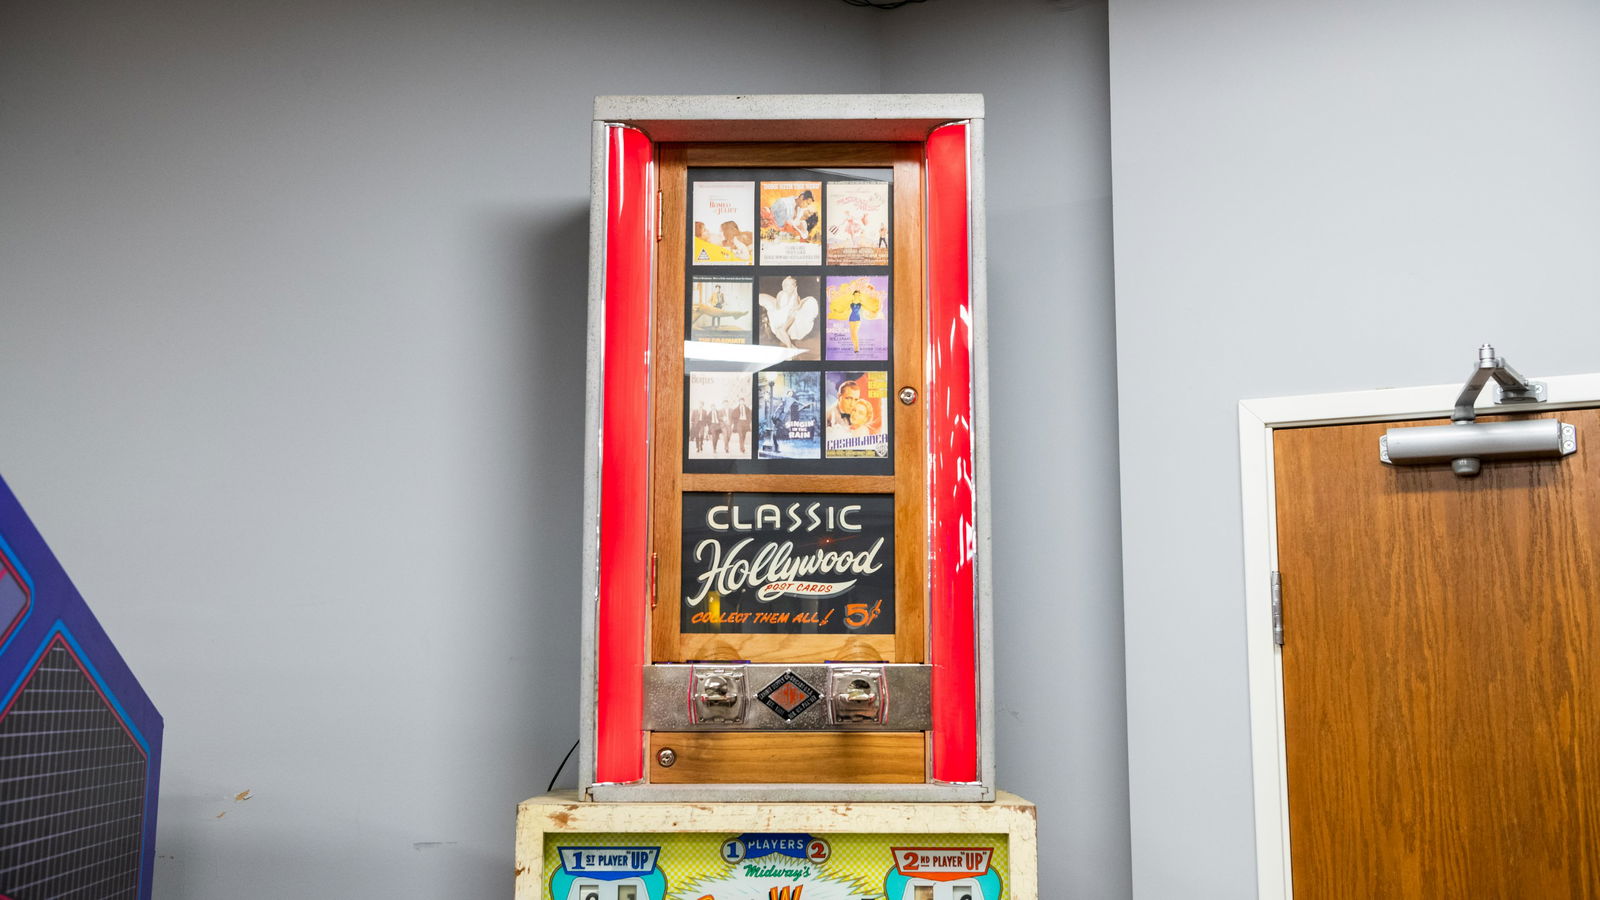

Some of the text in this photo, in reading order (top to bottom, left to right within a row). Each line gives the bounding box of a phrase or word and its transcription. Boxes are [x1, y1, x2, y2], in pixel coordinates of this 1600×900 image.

[788, 431, 811, 439] RAIN
[827, 433, 888, 451] CASABLANCA
[707, 502, 862, 532] CLASSIC
[686, 537, 885, 606] Hollywood
[764, 582, 833, 593] POST CARDS
[691, 612, 752, 624] COLLECT
[753, 612, 790, 624] THEM
[726, 839, 827, 859] 1 PLAYERS 2
[598, 855, 628, 866] PLAYER
[932, 855, 963, 867] PLAYER
[743, 864, 811, 881] Midway's
